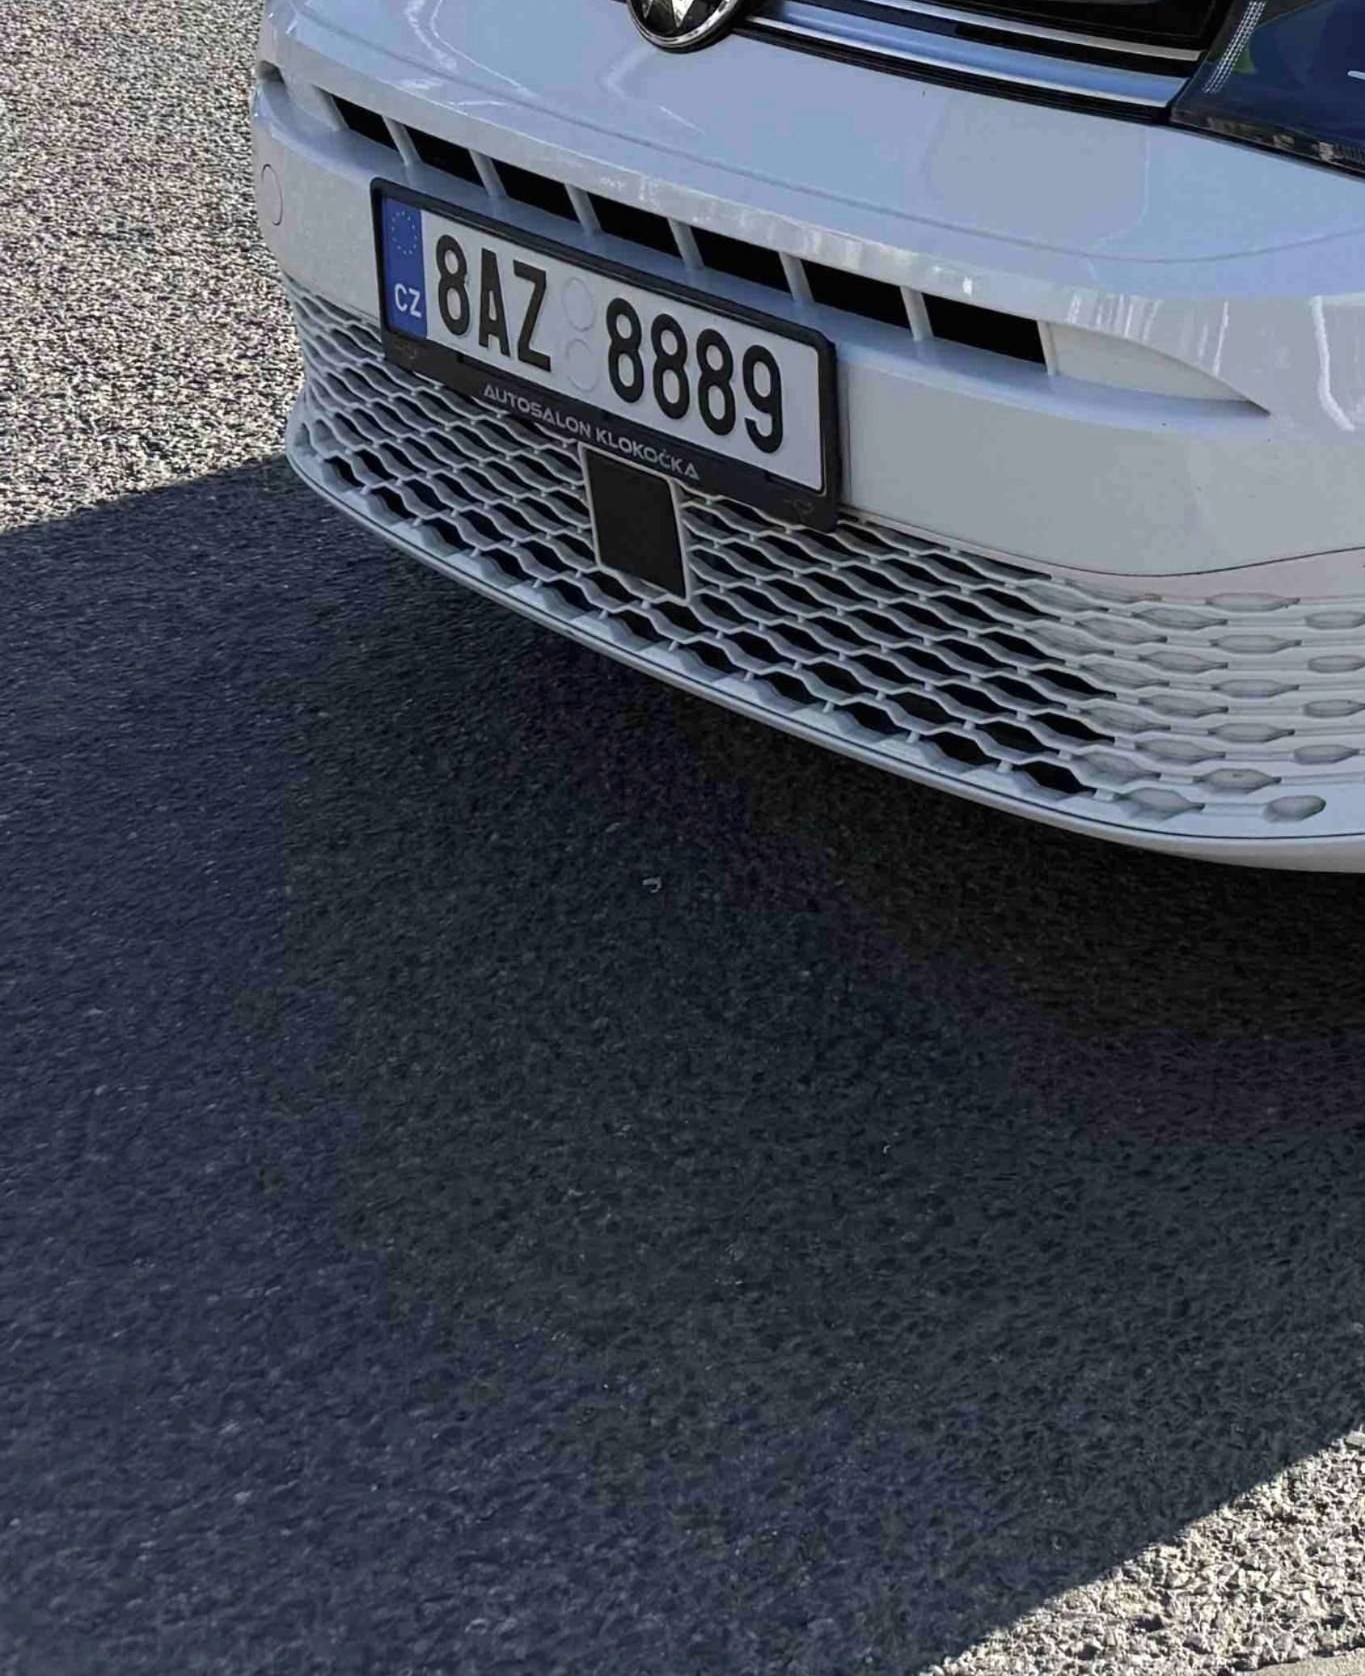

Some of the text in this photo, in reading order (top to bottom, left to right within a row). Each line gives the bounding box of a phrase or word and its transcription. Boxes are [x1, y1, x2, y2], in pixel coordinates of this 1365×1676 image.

[394, 283, 422, 318] CZ
[435, 235, 784, 454] 8AZ 8889
[482, 383, 593, 445] AUTOSALON
